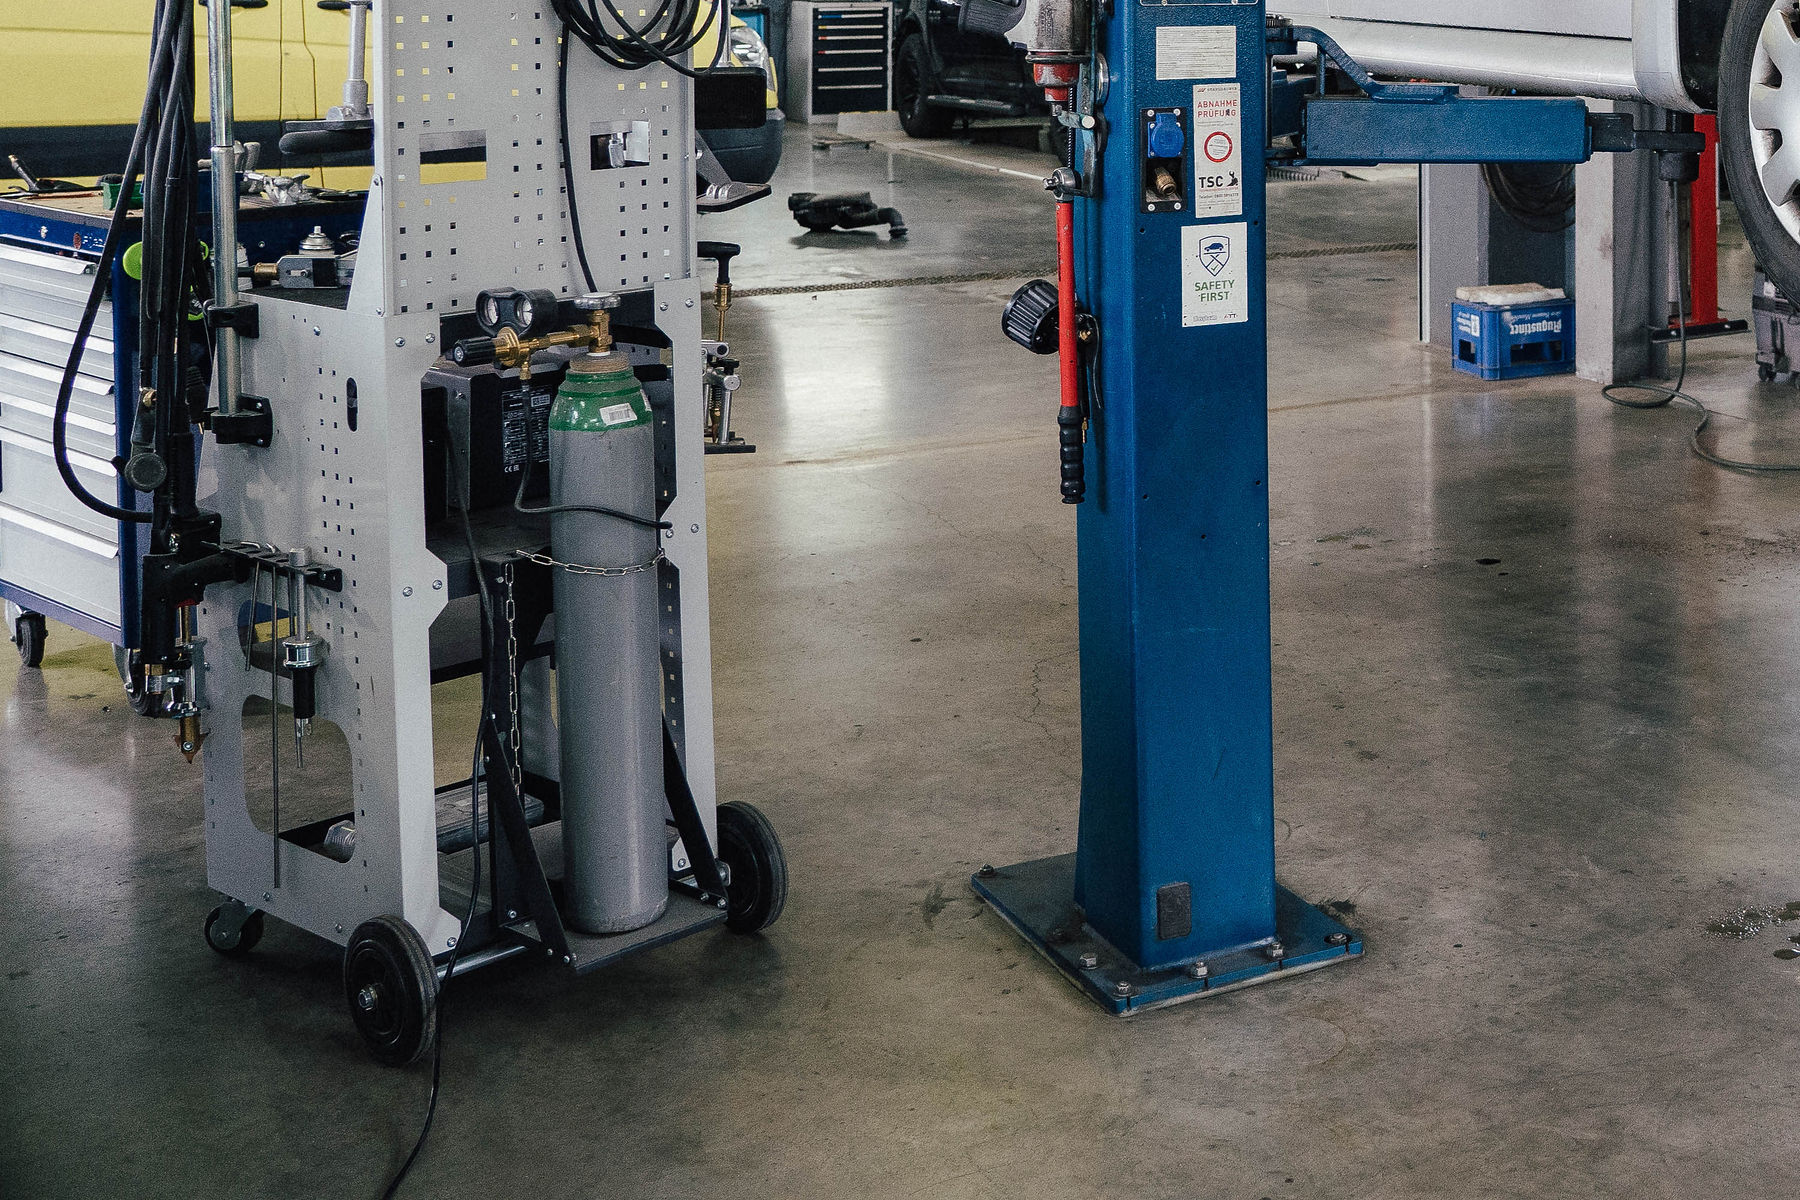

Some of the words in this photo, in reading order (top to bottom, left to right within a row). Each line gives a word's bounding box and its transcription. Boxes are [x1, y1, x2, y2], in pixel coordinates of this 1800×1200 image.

[1197, 100, 1238, 109] ABNAHME
[1198, 175, 1223, 188] TSC
[1195, 280, 1235, 292] SAFETY
[1200, 291, 1230, 302] FIRST
